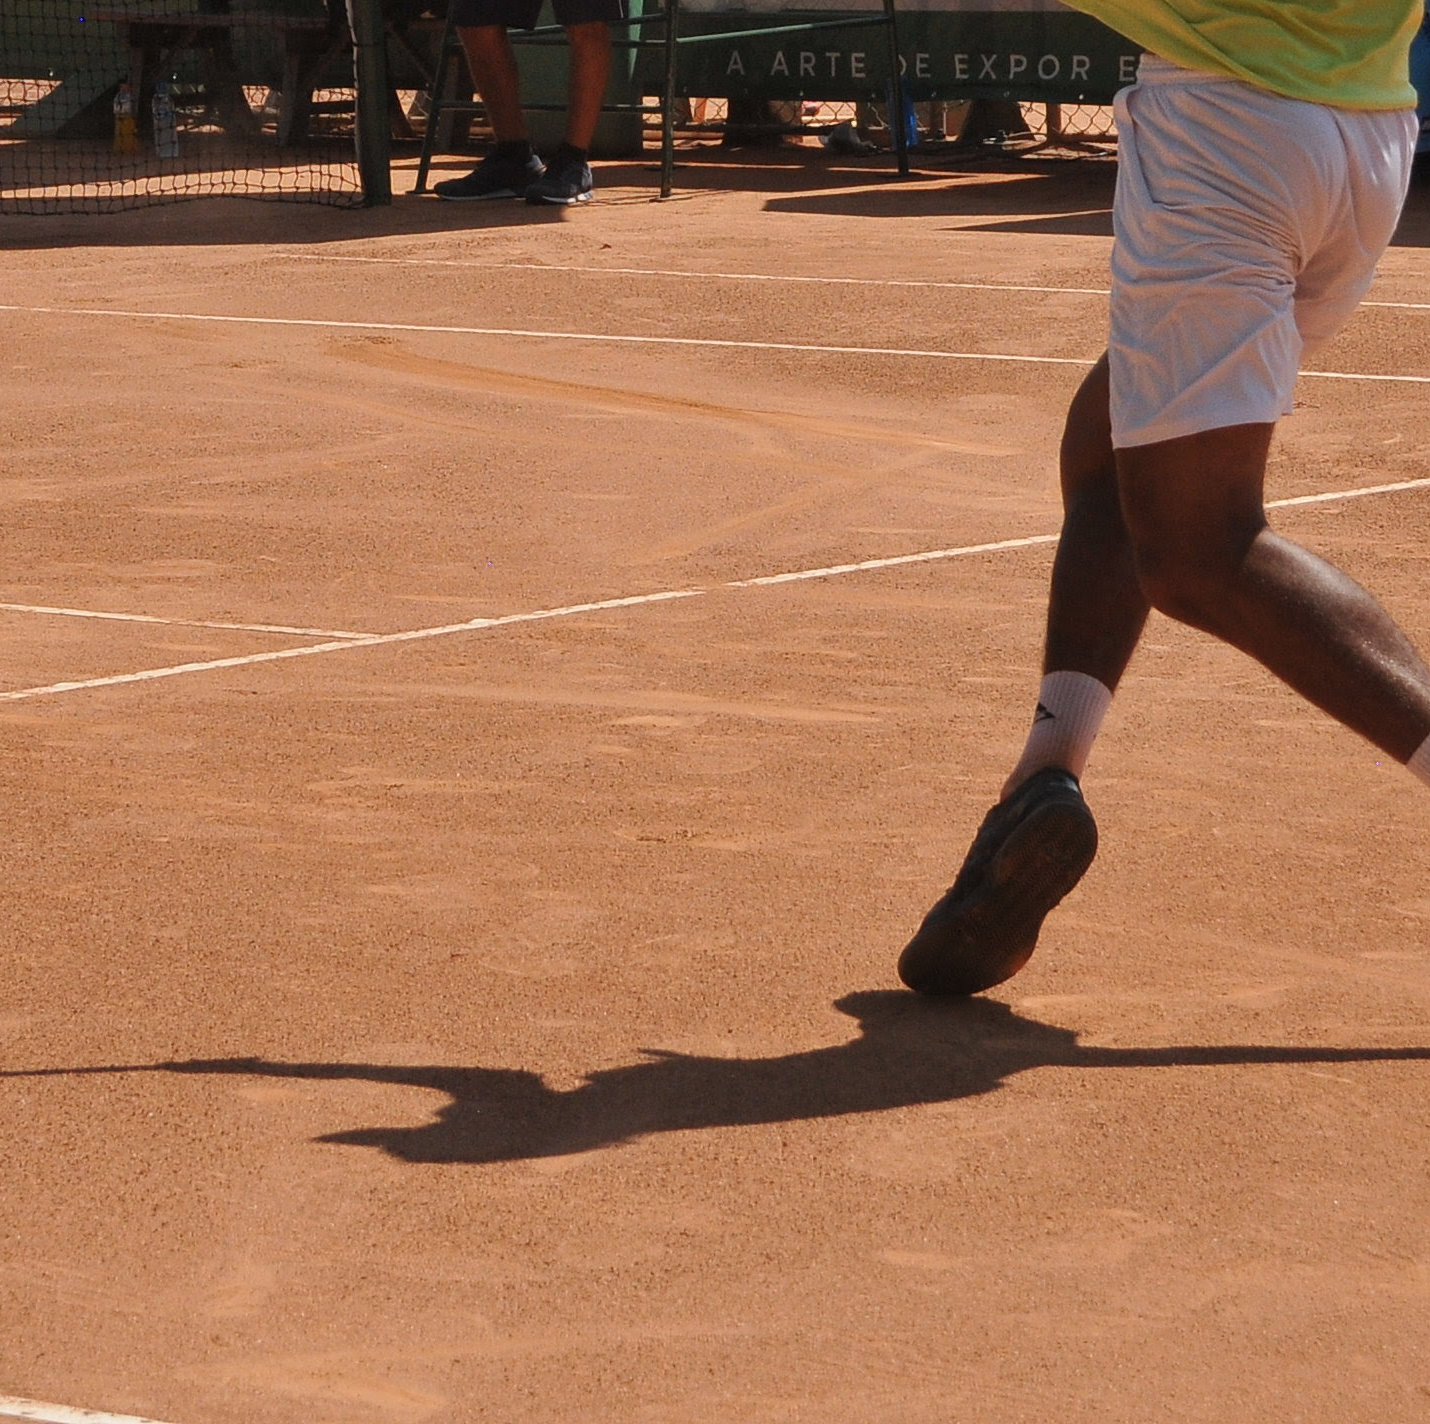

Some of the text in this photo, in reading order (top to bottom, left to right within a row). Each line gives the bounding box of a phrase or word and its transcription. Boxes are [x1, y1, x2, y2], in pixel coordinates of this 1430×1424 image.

[726, 51, 746, 75] A
[771, 51, 866, 77] ARTE
[954, 53, 1091, 81] EXPOR
[1118, 55, 1136, 82] E
